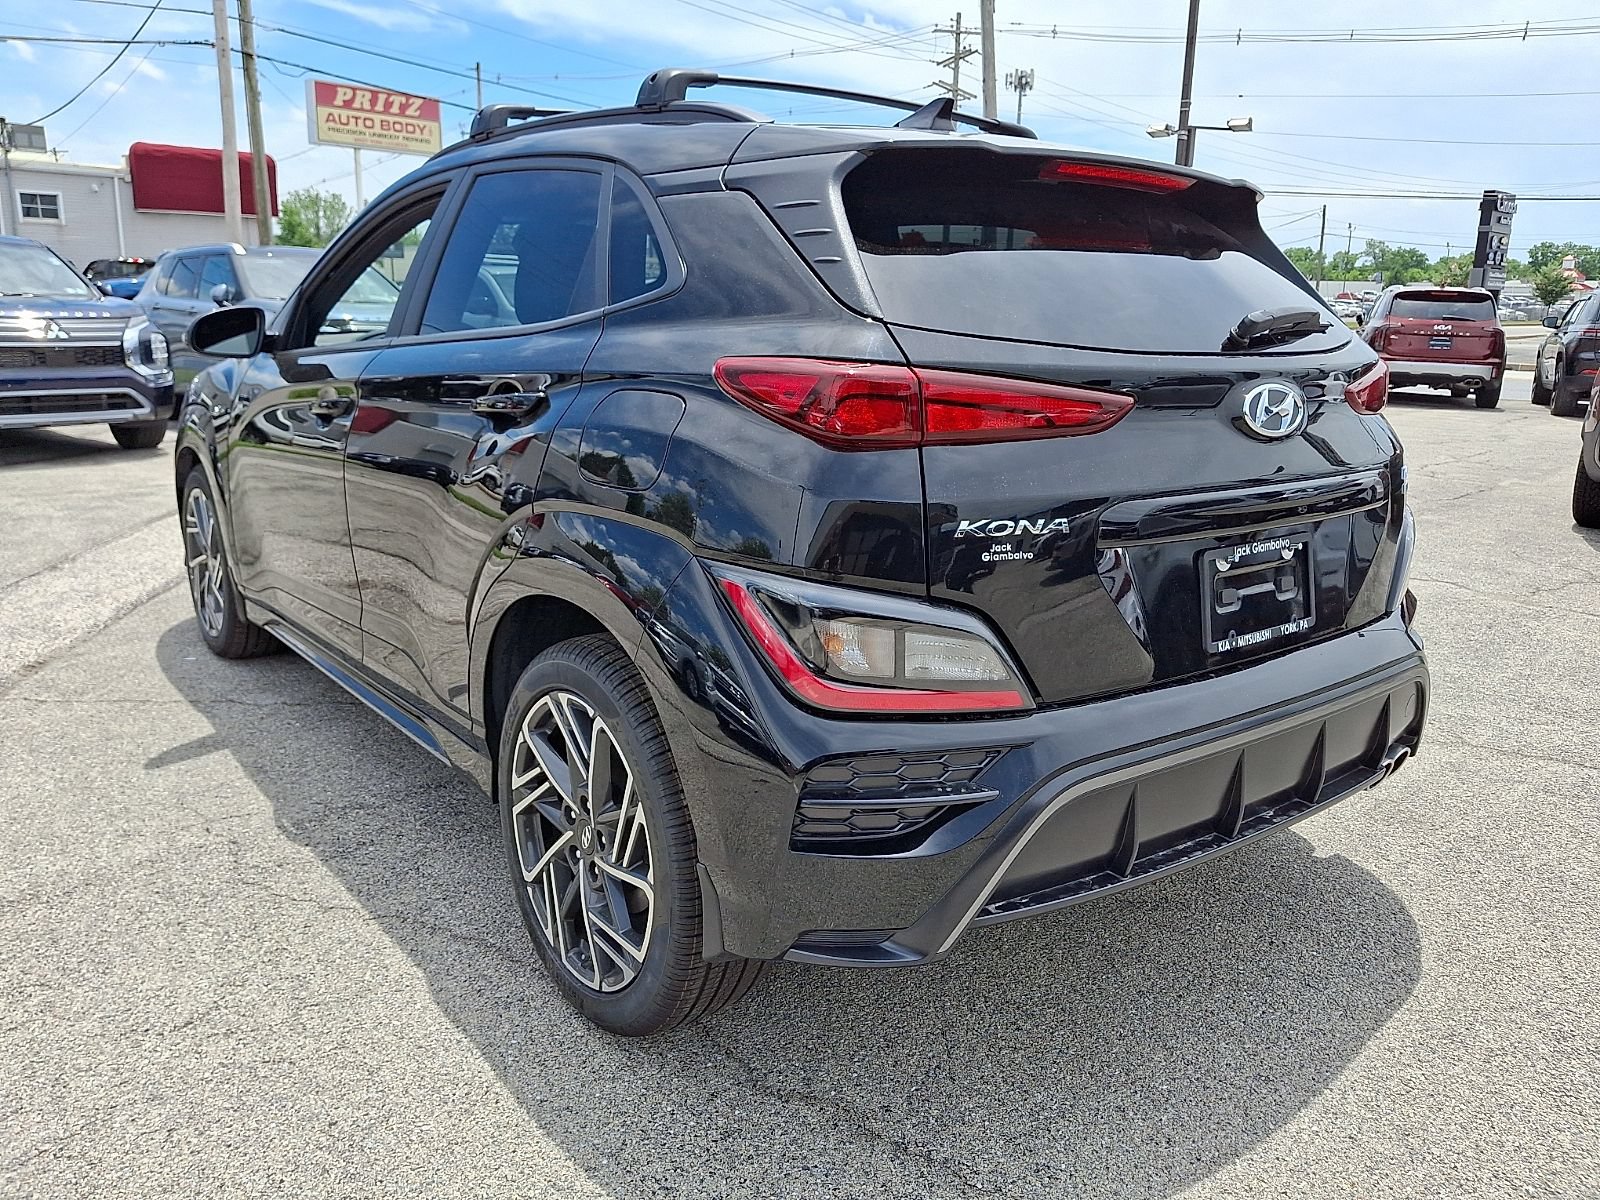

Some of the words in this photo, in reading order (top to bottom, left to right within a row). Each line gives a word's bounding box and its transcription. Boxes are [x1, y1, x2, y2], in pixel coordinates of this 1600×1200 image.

[333, 86, 424, 118] PRITZ
[325, 112, 375, 130] AUTO
[380, 119, 427, 137] BODY
[954, 518, 1070, 538] KONA
[982, 550, 1034, 562] Giambalvo
[990, 543, 1012, 553] Jack
[1252, 538, 1290, 554] Giambalvo
[1218, 640, 1231, 652] KIA
[1237, 629, 1272, 647] MITSUBISHI
[1300, 620, 1309, 631] PA
